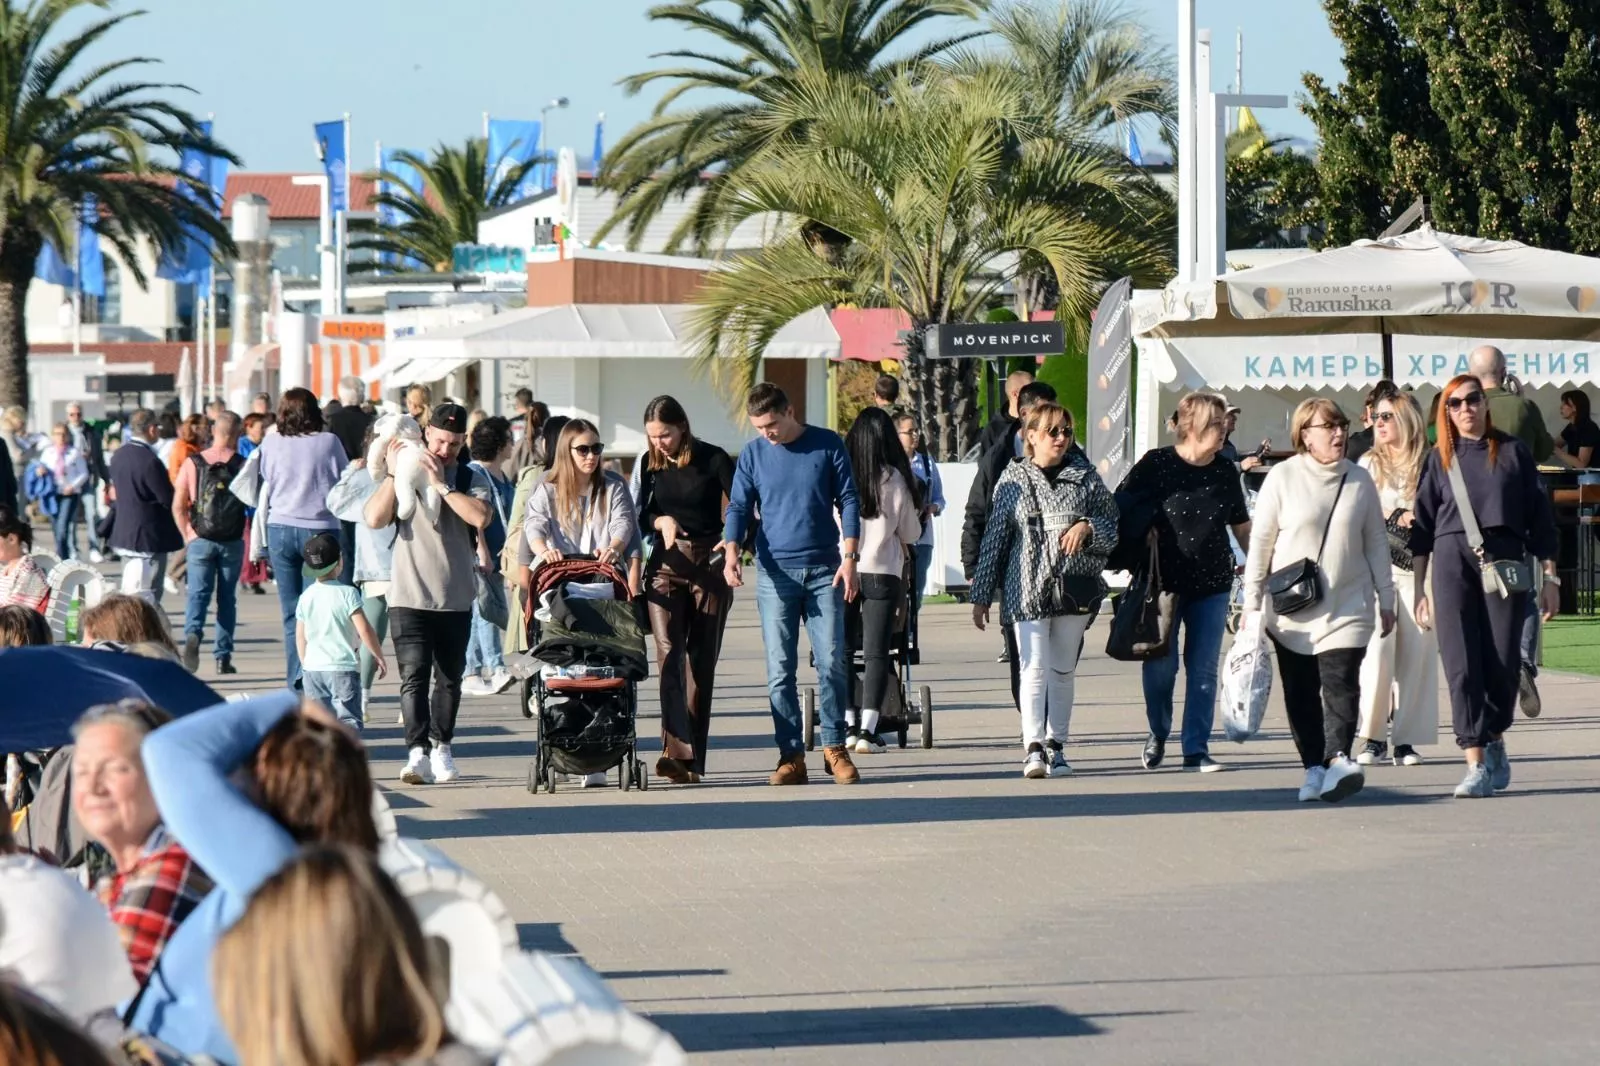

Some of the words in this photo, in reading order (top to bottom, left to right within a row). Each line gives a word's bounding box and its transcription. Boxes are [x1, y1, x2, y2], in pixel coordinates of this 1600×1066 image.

[1287, 284, 1393, 296] ДИВНОМОРСКАЯ
[1441, 281, 1457, 308] I
[1490, 281, 1518, 308] R
[953, 333, 1052, 346] MÖVENPICK
[1408, 352, 1589, 377] ХРАЕНИЯ
